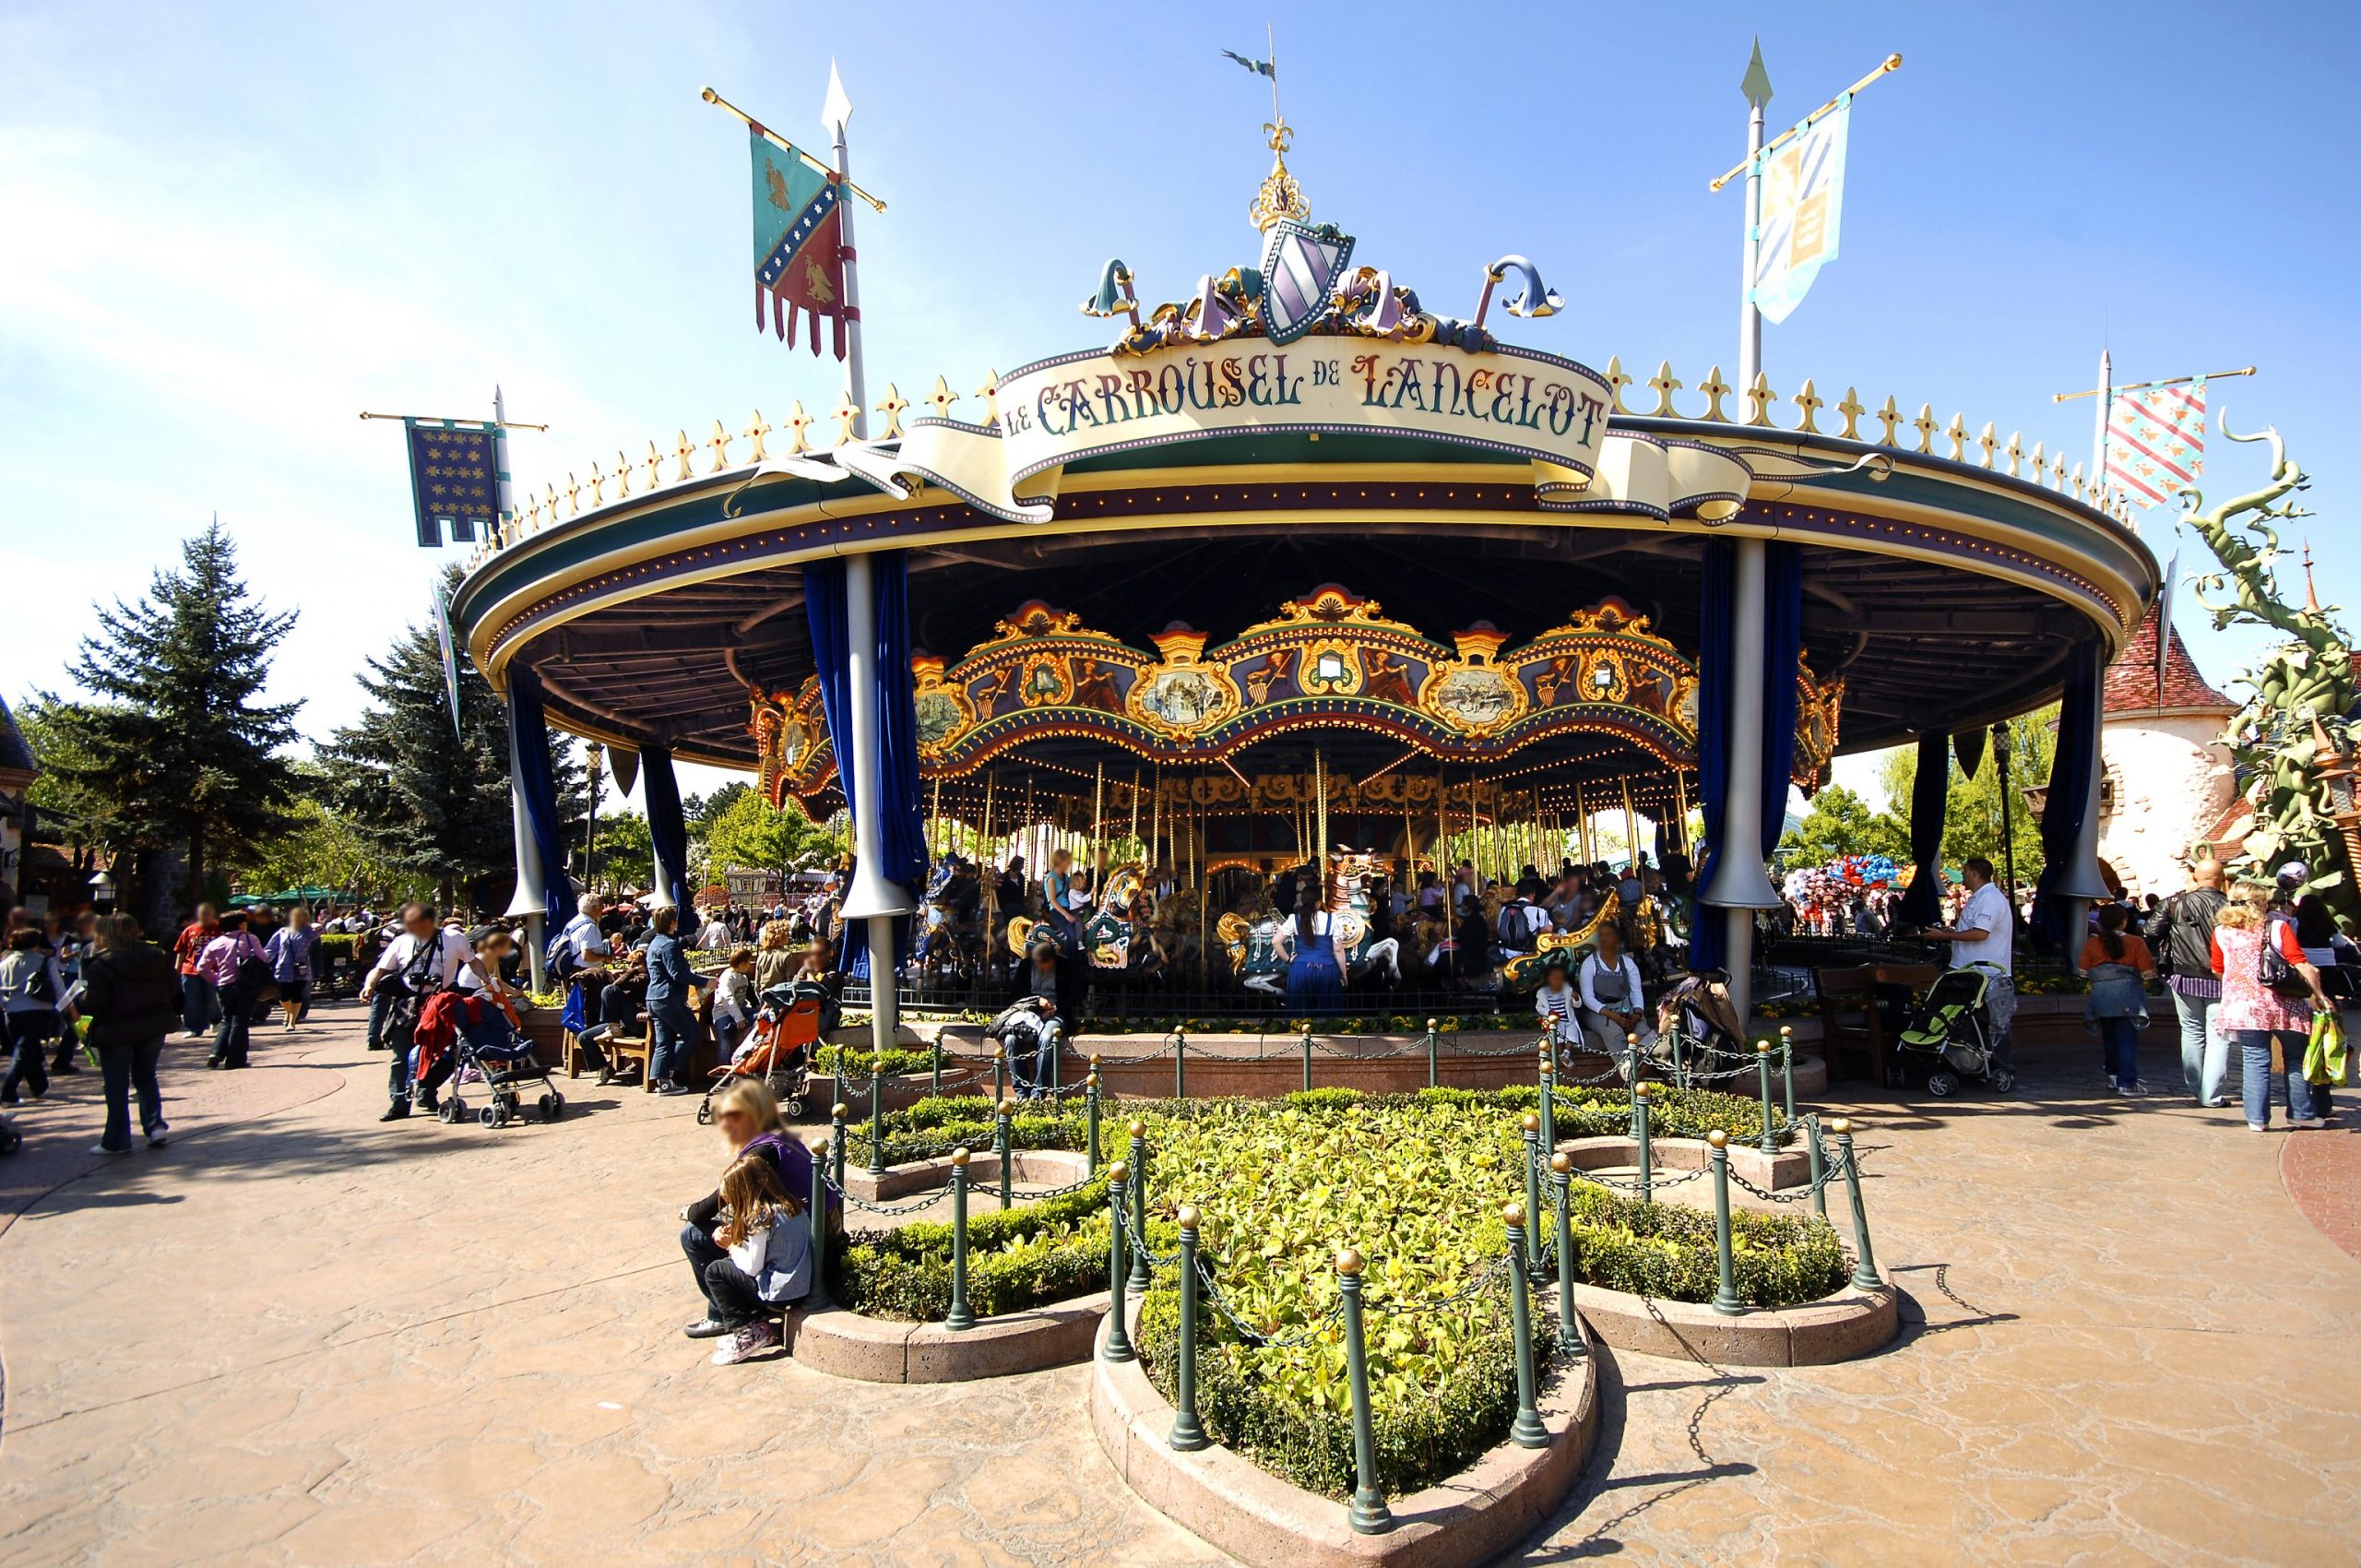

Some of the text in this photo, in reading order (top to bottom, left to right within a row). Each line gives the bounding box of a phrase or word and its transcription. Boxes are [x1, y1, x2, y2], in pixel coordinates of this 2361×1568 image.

[1005, 354, 1605, 448] LE CARROUSEL DE LANCELOT
